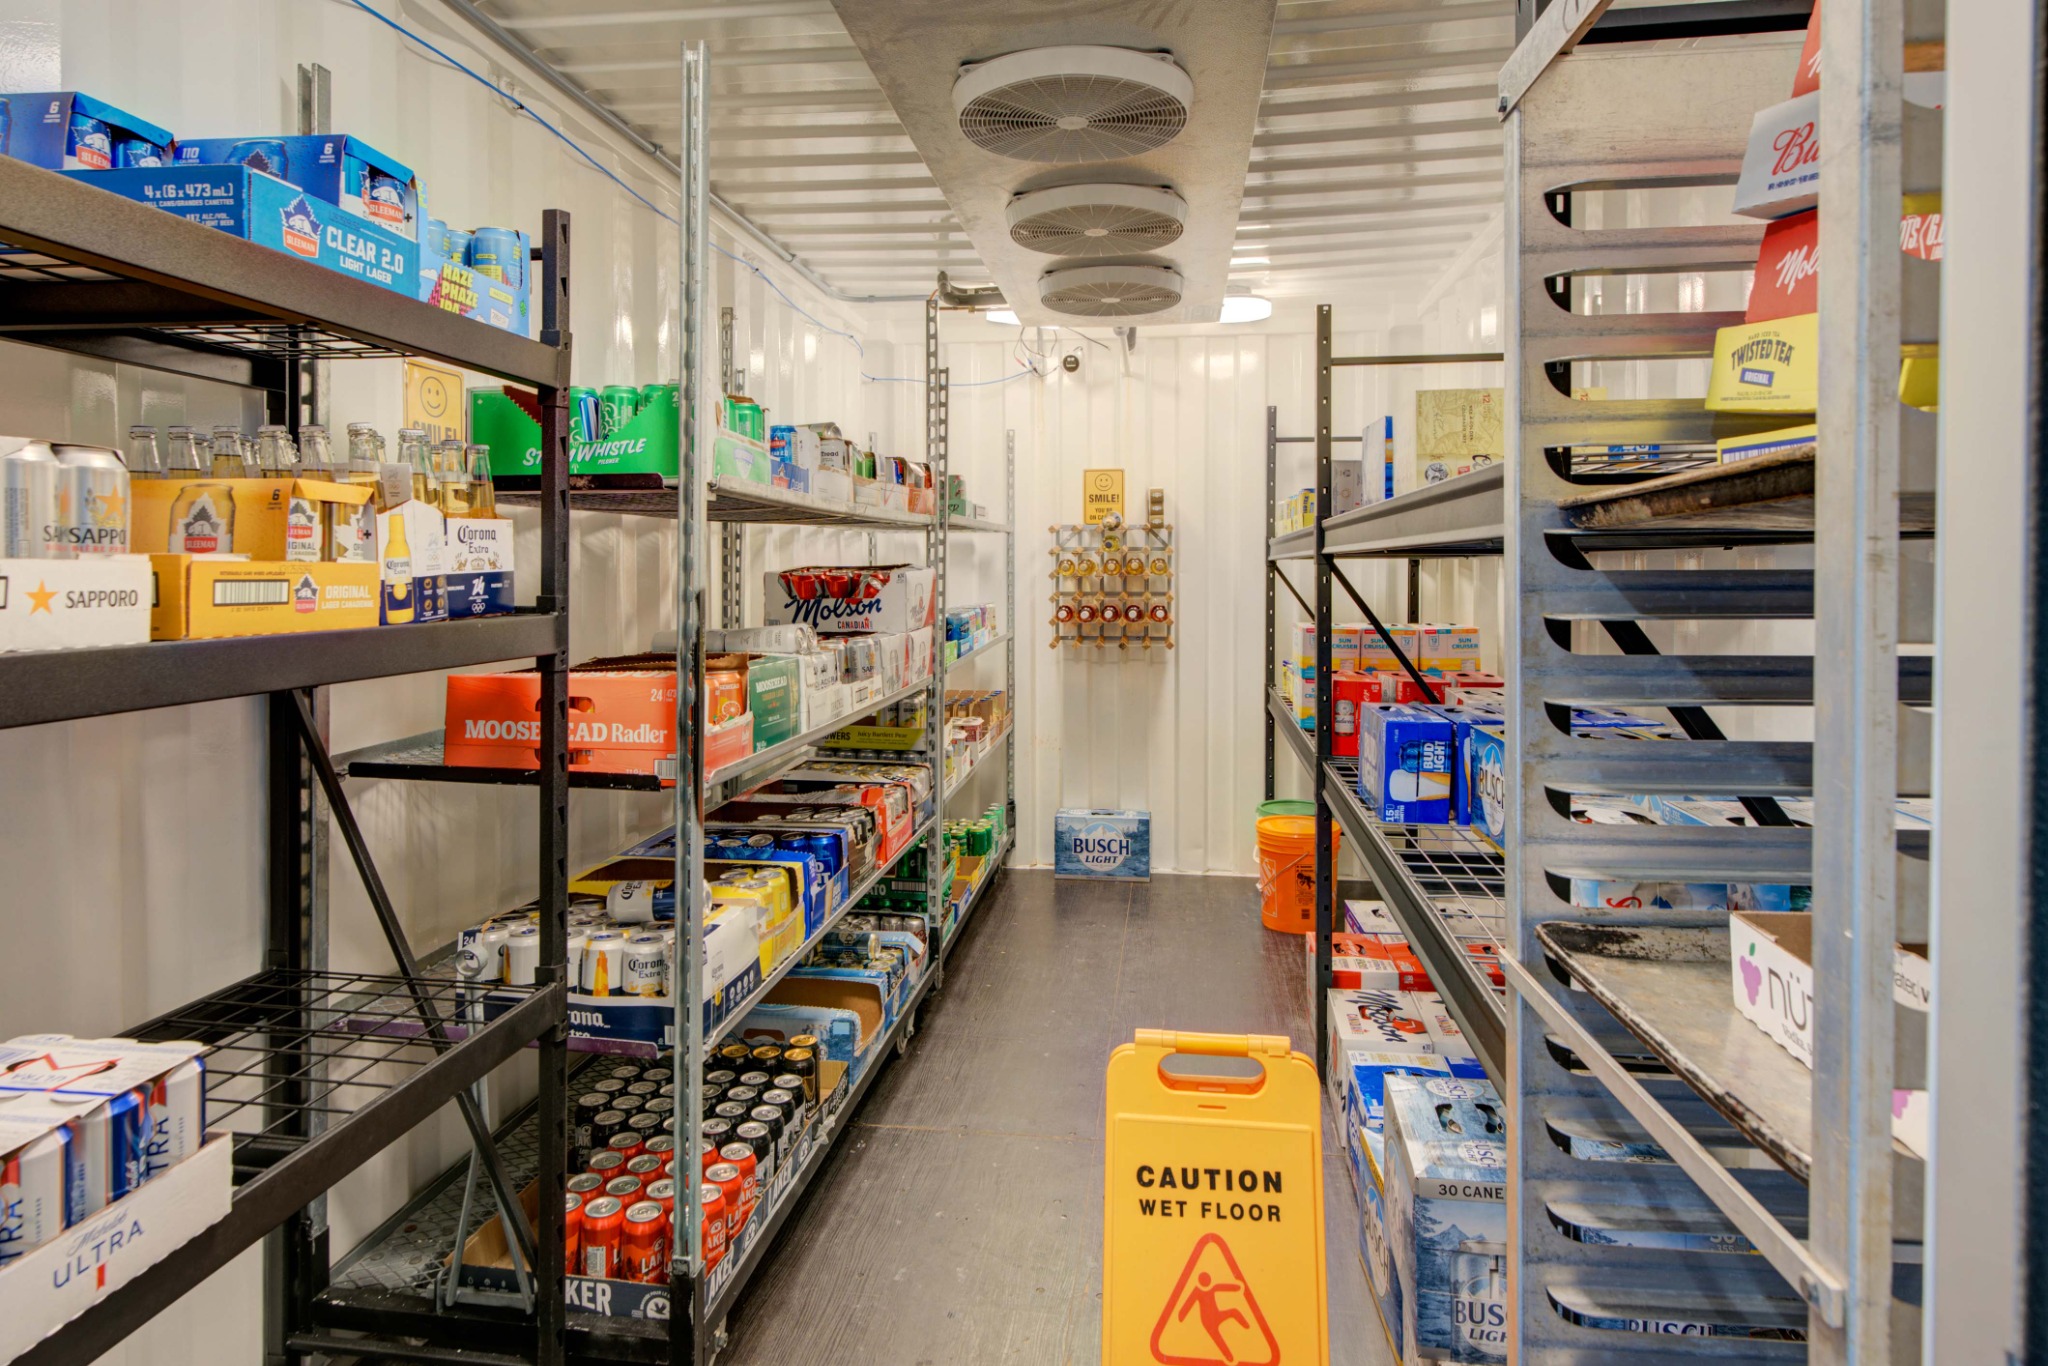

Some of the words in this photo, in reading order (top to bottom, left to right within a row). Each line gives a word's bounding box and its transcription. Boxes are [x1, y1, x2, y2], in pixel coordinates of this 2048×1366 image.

[50, 101, 60, 114] 6
[182, 147, 200, 159] 110
[324, 143, 334, 154] 6
[285, 234, 316, 253] SLEEMAN
[326, 225, 377, 264] CLEAR
[381, 247, 404, 275] 2.0
[340, 255, 365, 274] LIGHT
[366, 265, 393, 285] LAGER
[443, 262, 474, 289] HAZE
[441, 279, 479, 309] PHAZE
[1731, 338, 1774, 371] TWISTED
[1774, 339, 1794, 367] TEA
[577, 437, 647, 463] WHISTLE
[271, 488, 281, 501] 6
[1088, 493, 1120, 504] SMILE!
[185, 539, 217, 549] SLEEMAN
[457, 525, 497, 544] Corona
[468, 542, 489, 554] Extra
[65, 589, 139, 609] SAPPORO
[325, 585, 371, 599] ORIGINAL
[321, 601, 341, 610] LAGER
[784, 595, 883, 629] Molson
[837, 616, 870, 630] CANADIAN
[650, 689, 663, 703] 24
[611, 723, 668, 744] Radler
[1422, 742, 1435, 770] BUD
[1434, 740, 1446, 773] LIGHT
[1073, 837, 1131, 857] BUSCH
[1084, 855, 1119, 865] LIGHT
[1136, 1164, 1283, 1194] CAUTION
[1438, 1184, 1458, 1197] 30
[1139, 1198, 1189, 1218] WET
[1201, 1201, 1282, 1223] FLOOR
[53, 1219, 146, 1289] ULTRA
[1455, 1300, 1506, 1327] BUS
